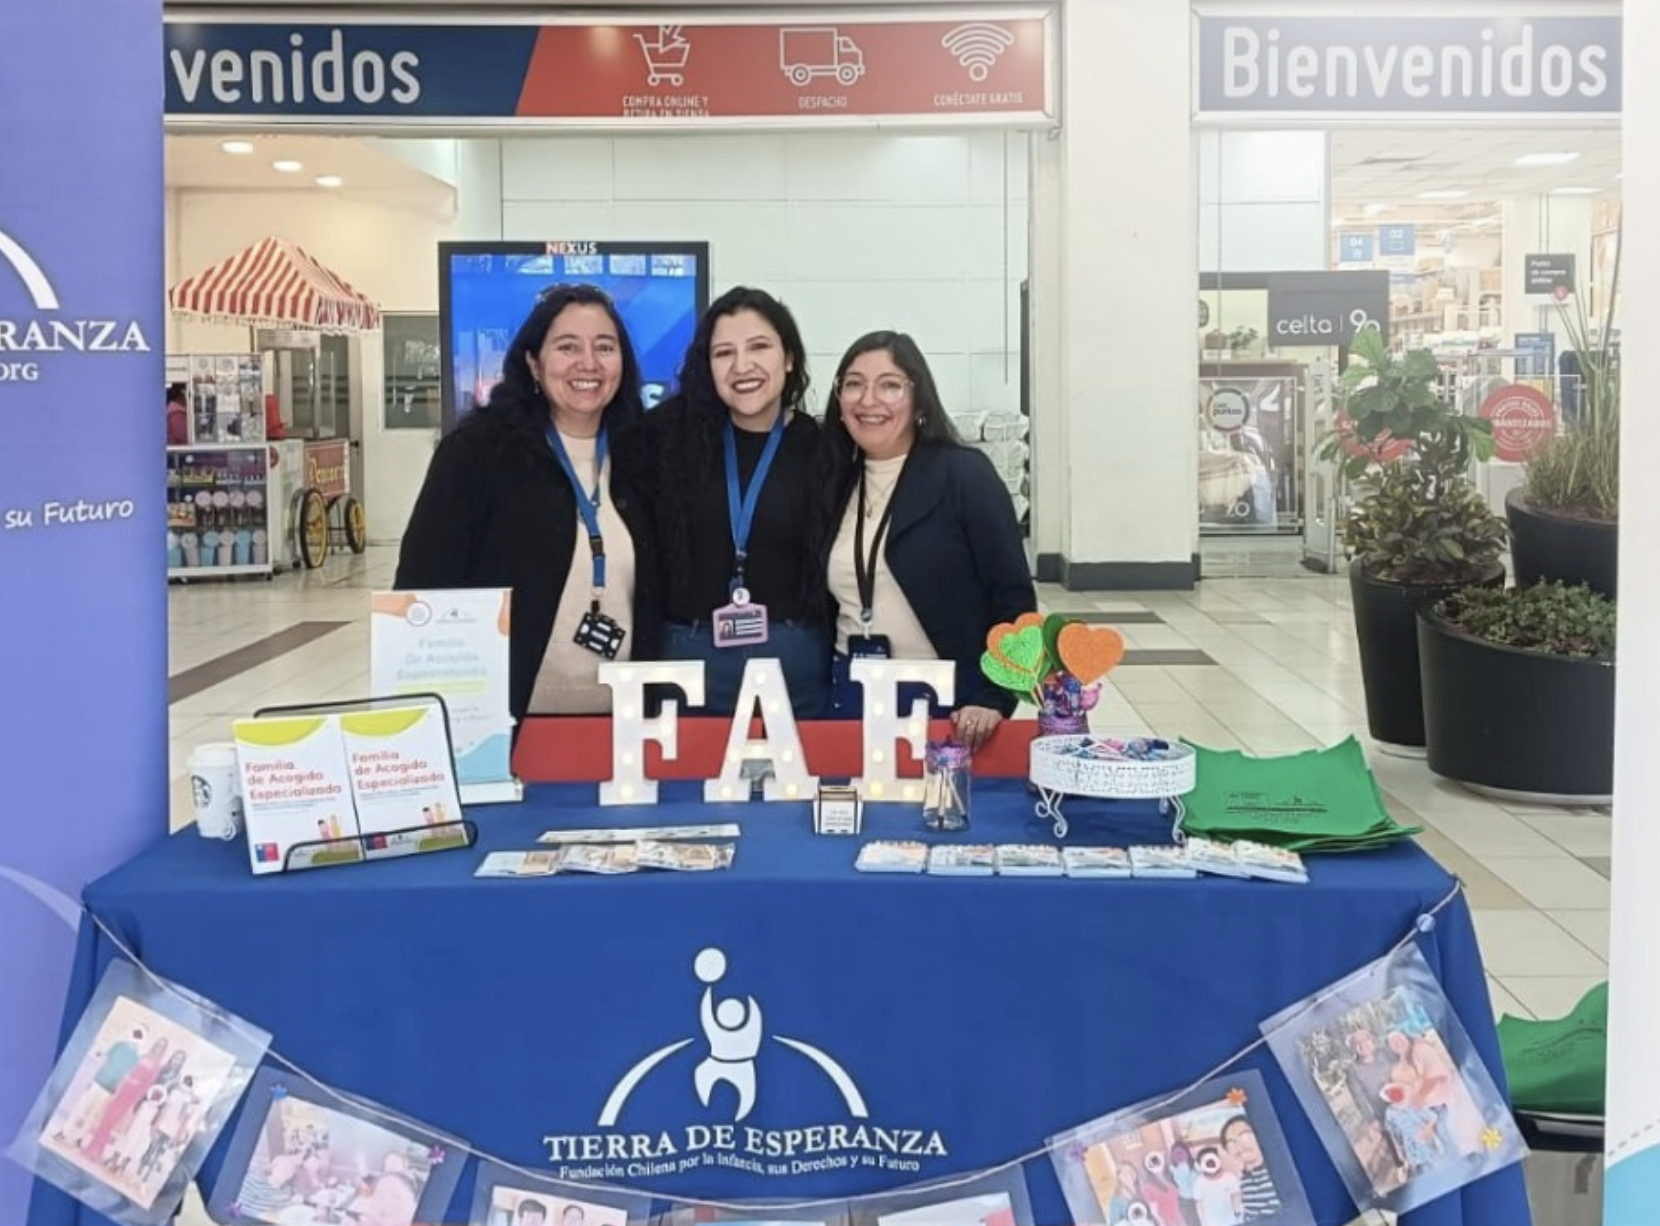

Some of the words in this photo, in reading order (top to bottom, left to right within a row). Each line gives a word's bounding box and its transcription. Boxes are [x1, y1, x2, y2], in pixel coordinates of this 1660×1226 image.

[170, 29, 421, 104] venidos
[1223, 24, 1608, 98] Bienvenidos
[622, 95, 662, 108] COMPRA
[664, 95, 700, 108] ONLINE
[799, 95, 848, 109] DESPACHO
[933, 92, 988, 107] CONÉCTATE
[989, 91, 1024, 104] GRATIS
[545, 241, 598, 255] NEXUS
[1276, 313, 1333, 335] celta
[5, 510, 33, 529] su
[43, 500, 135, 526] Futuro
[352, 750, 400, 762] Familia
[245, 760, 295, 772] Familia
[354, 765, 371, 776] de
[375, 758, 427, 773] Acogida
[247, 775, 264, 786] de
[268, 770, 324, 785] Acogida
[357, 771, 445, 791] Especializada
[249, 784, 342, 801] Especializada
[542, 1131, 679, 1162] TIERRA
[685, 1124, 736, 1151] DE
[743, 1124, 949, 1157] ESPERANZA
[559, 1163, 625, 1180] Fundación
[627, 1160, 677, 1177] Chilena
[678, 1156, 700, 1174] por
[702, 1152, 715, 1165] la
[767, 1163, 788, 1175] sus
[791, 1154, 848, 1175] Derechos
[849, 1155, 859, 1169] y
[861, 1155, 876, 1167] su
[878, 1154, 921, 1173] Futuro
